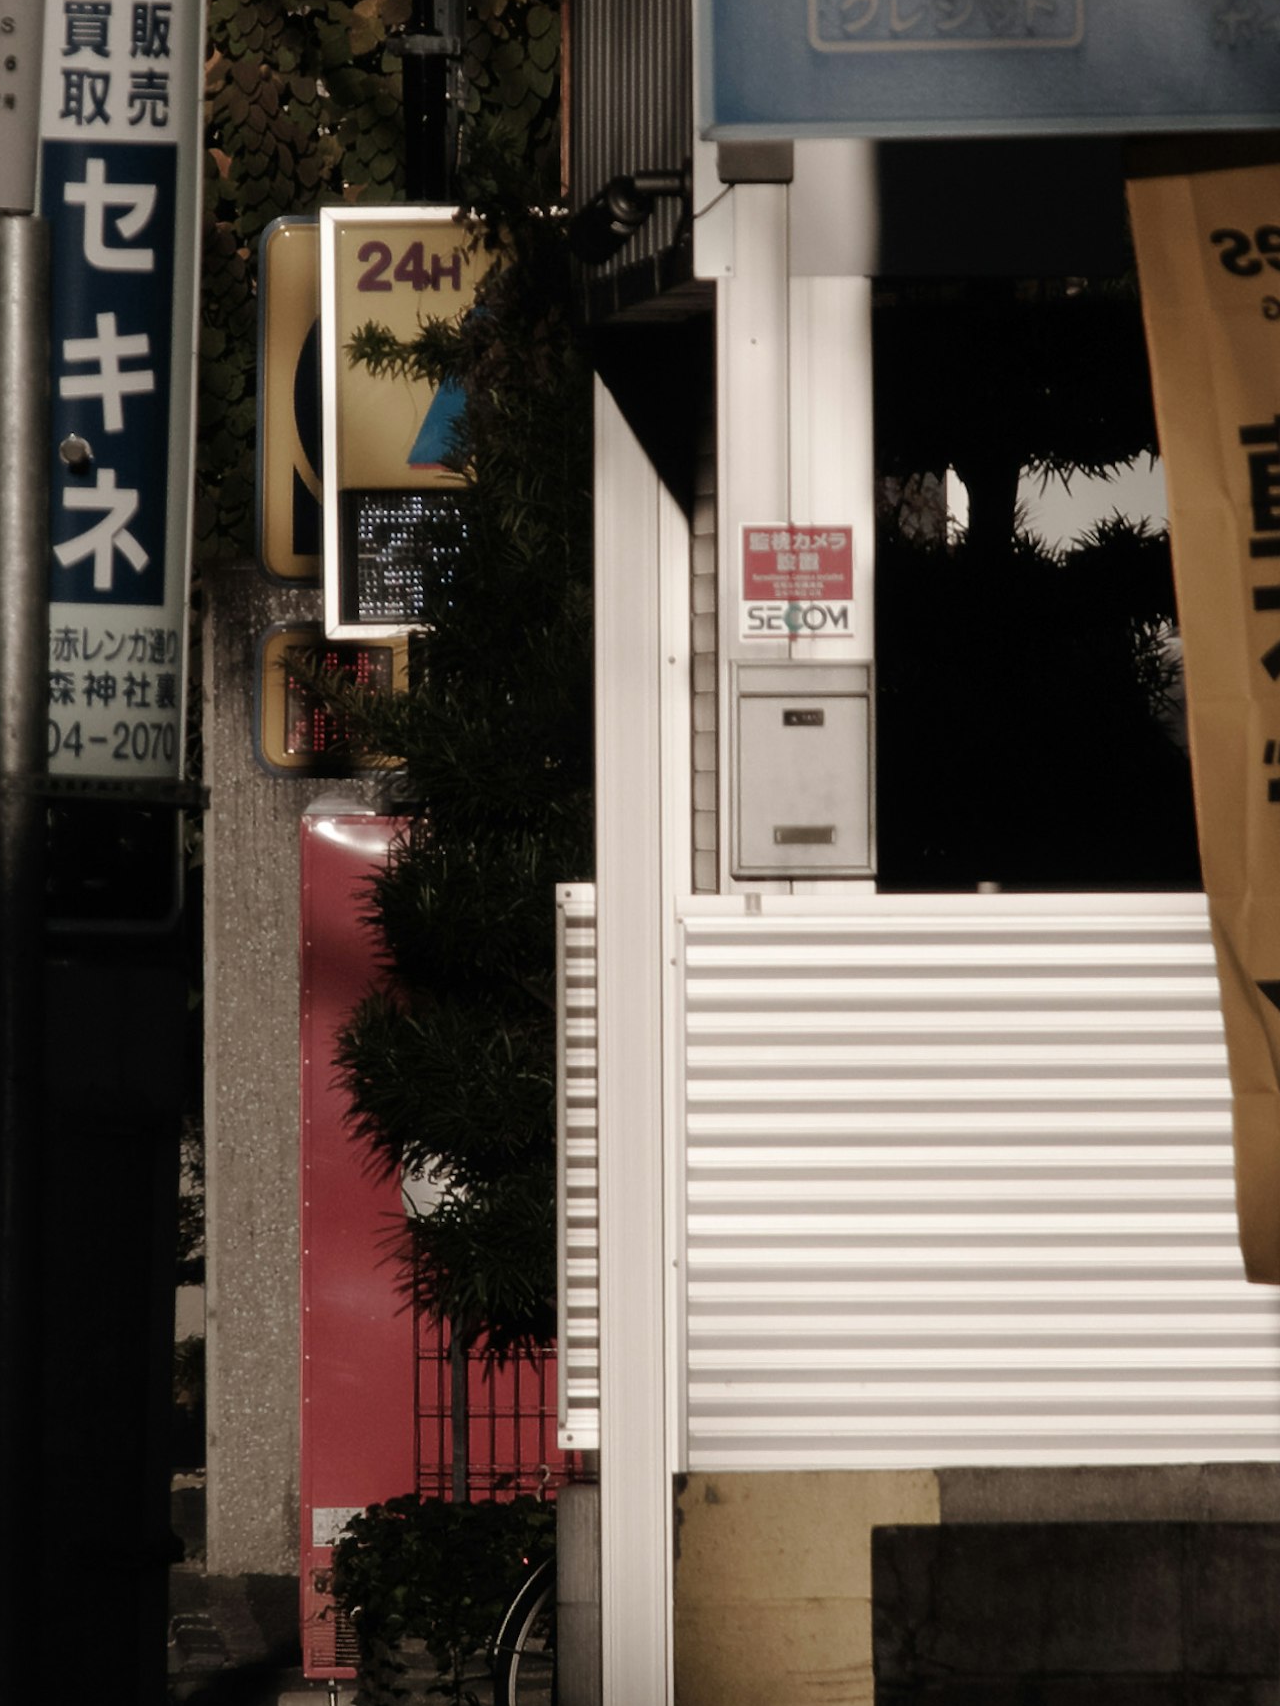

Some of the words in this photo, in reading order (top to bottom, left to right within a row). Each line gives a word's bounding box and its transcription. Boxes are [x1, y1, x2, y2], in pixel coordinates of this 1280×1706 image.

[356, 241, 463, 292] 24H
[53, 157, 158, 592] セキネ
[747, 604, 849, 632] SECOM
[49, 624, 178, 664] 赤レンガ通り
